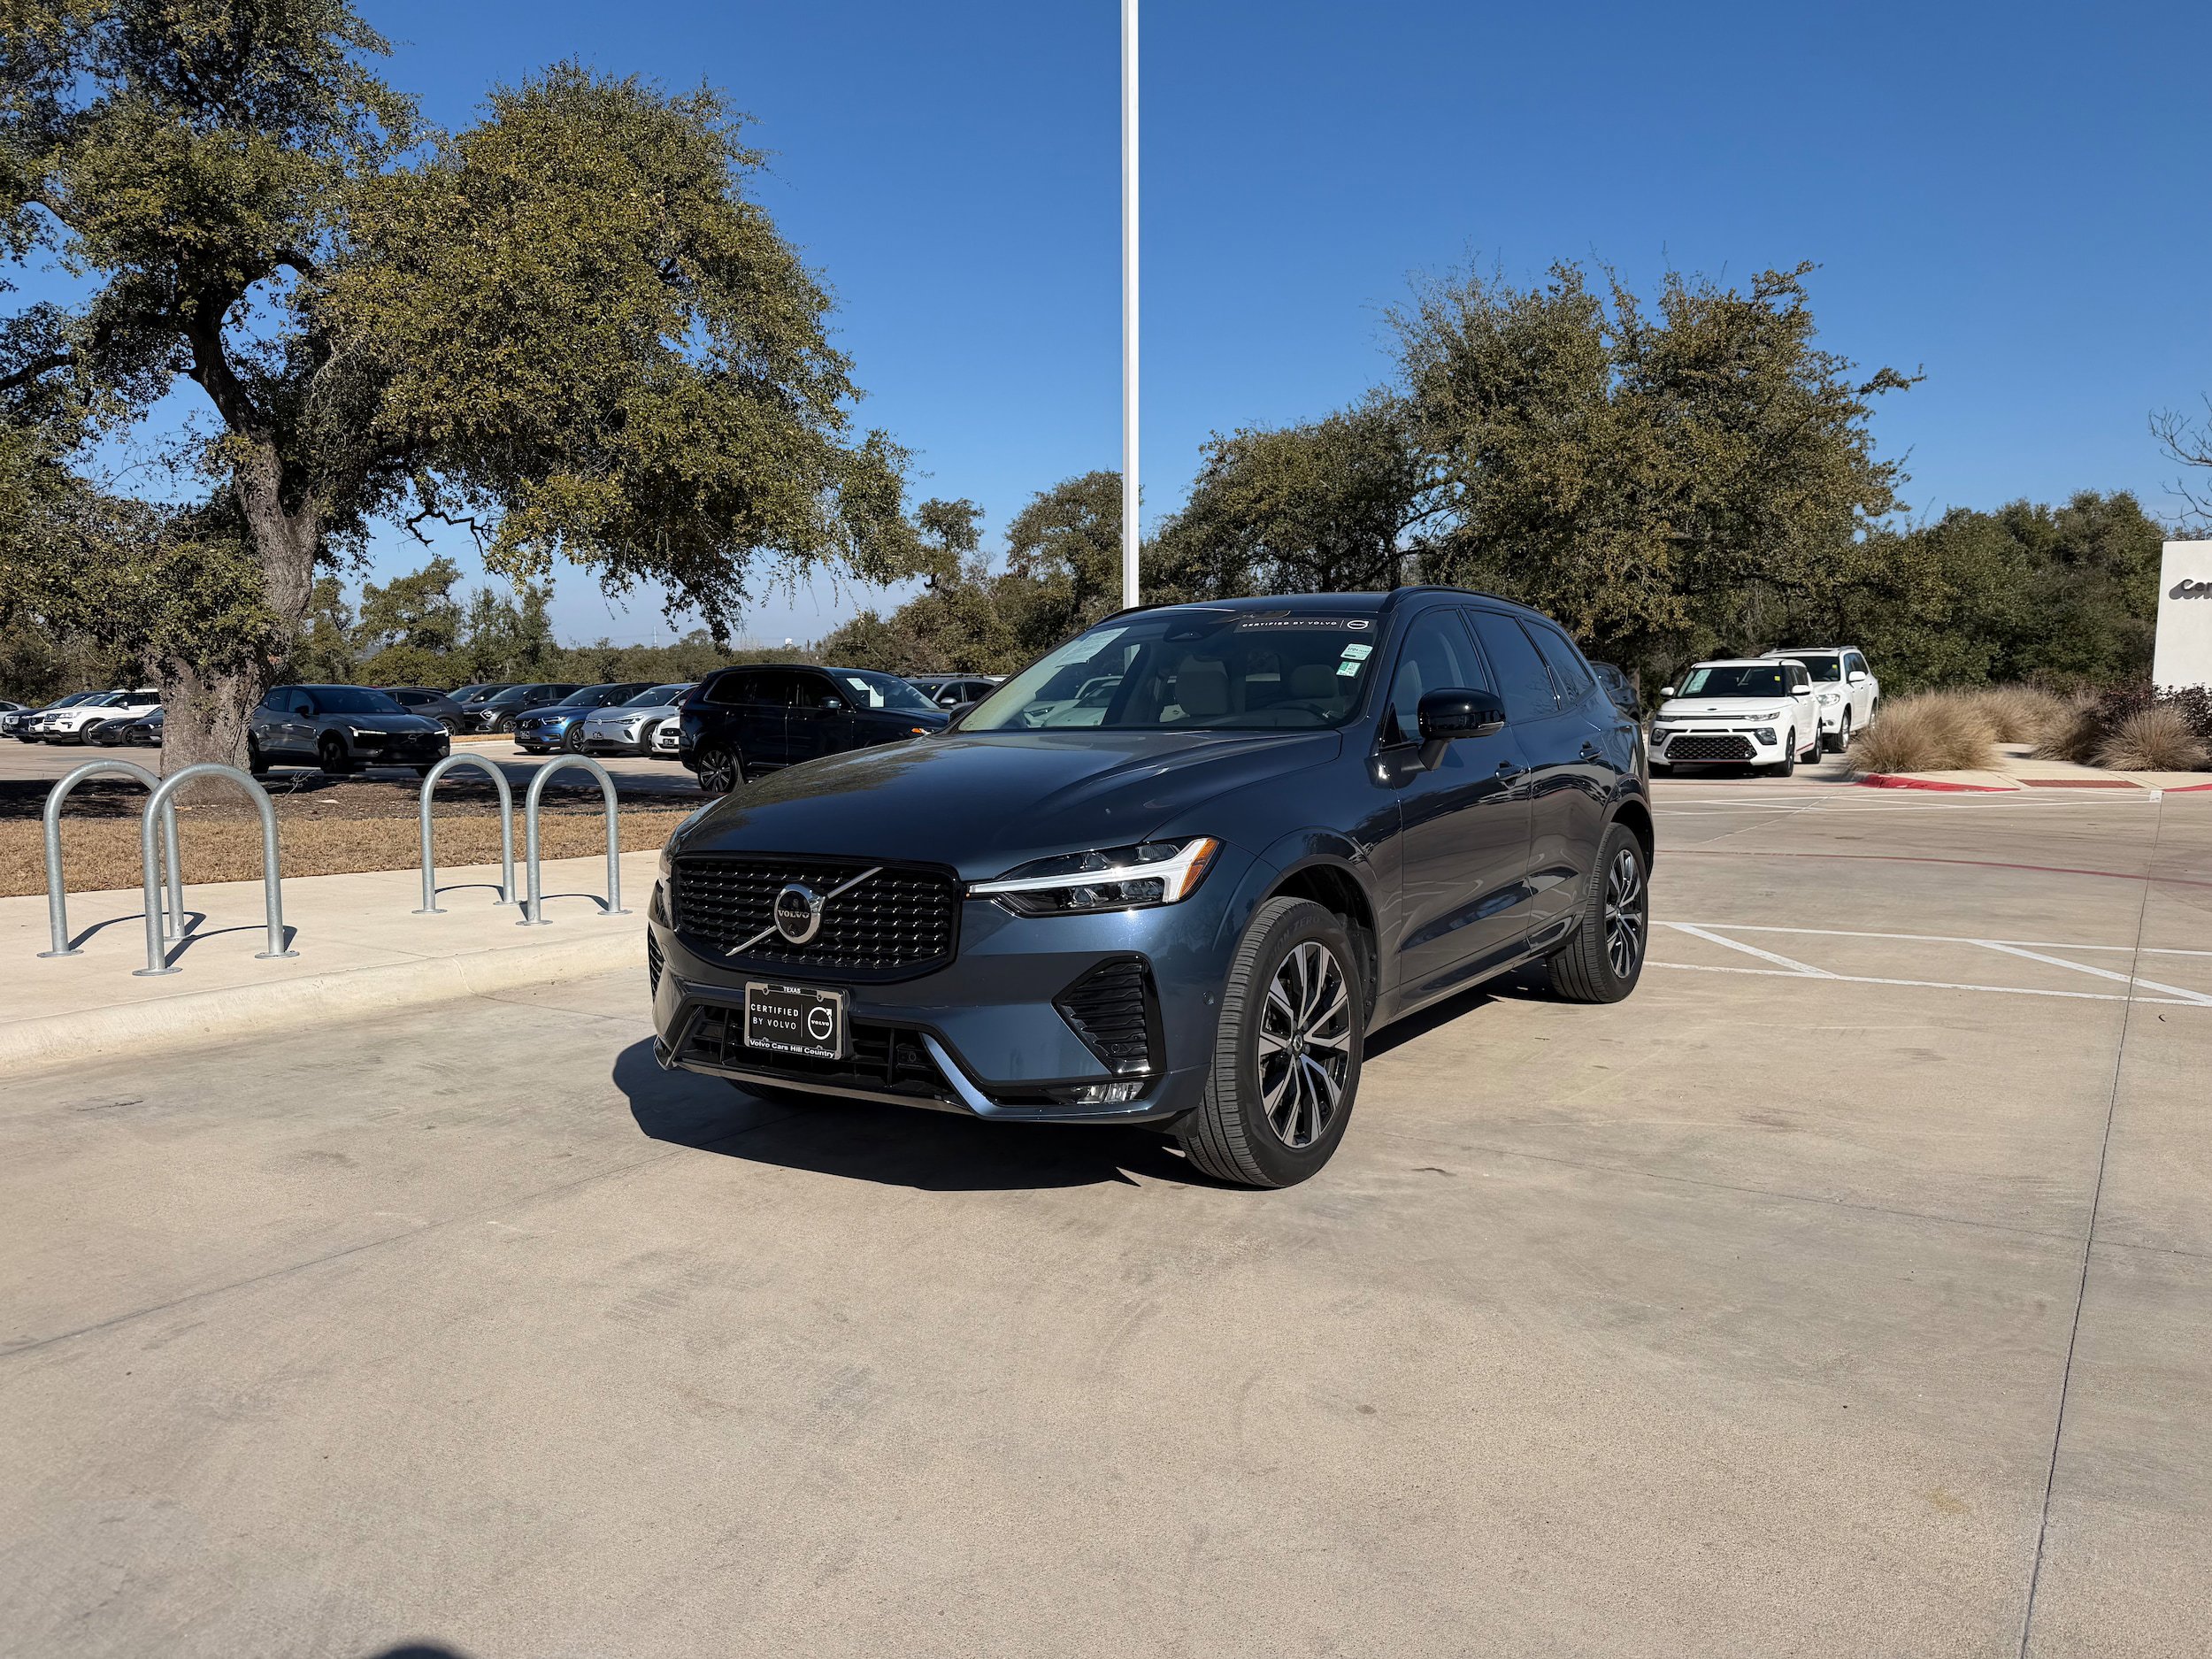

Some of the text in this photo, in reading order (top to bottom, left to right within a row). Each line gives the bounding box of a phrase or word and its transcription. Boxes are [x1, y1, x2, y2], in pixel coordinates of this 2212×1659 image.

[778, 910, 810, 918] VOLVO
[750, 1003, 799, 1017] CERTIFIED
[767, 1019, 796, 1030] VOLVO
[749, 1039, 770, 1048] Volvo
[804, 1048, 834, 1058] Country
